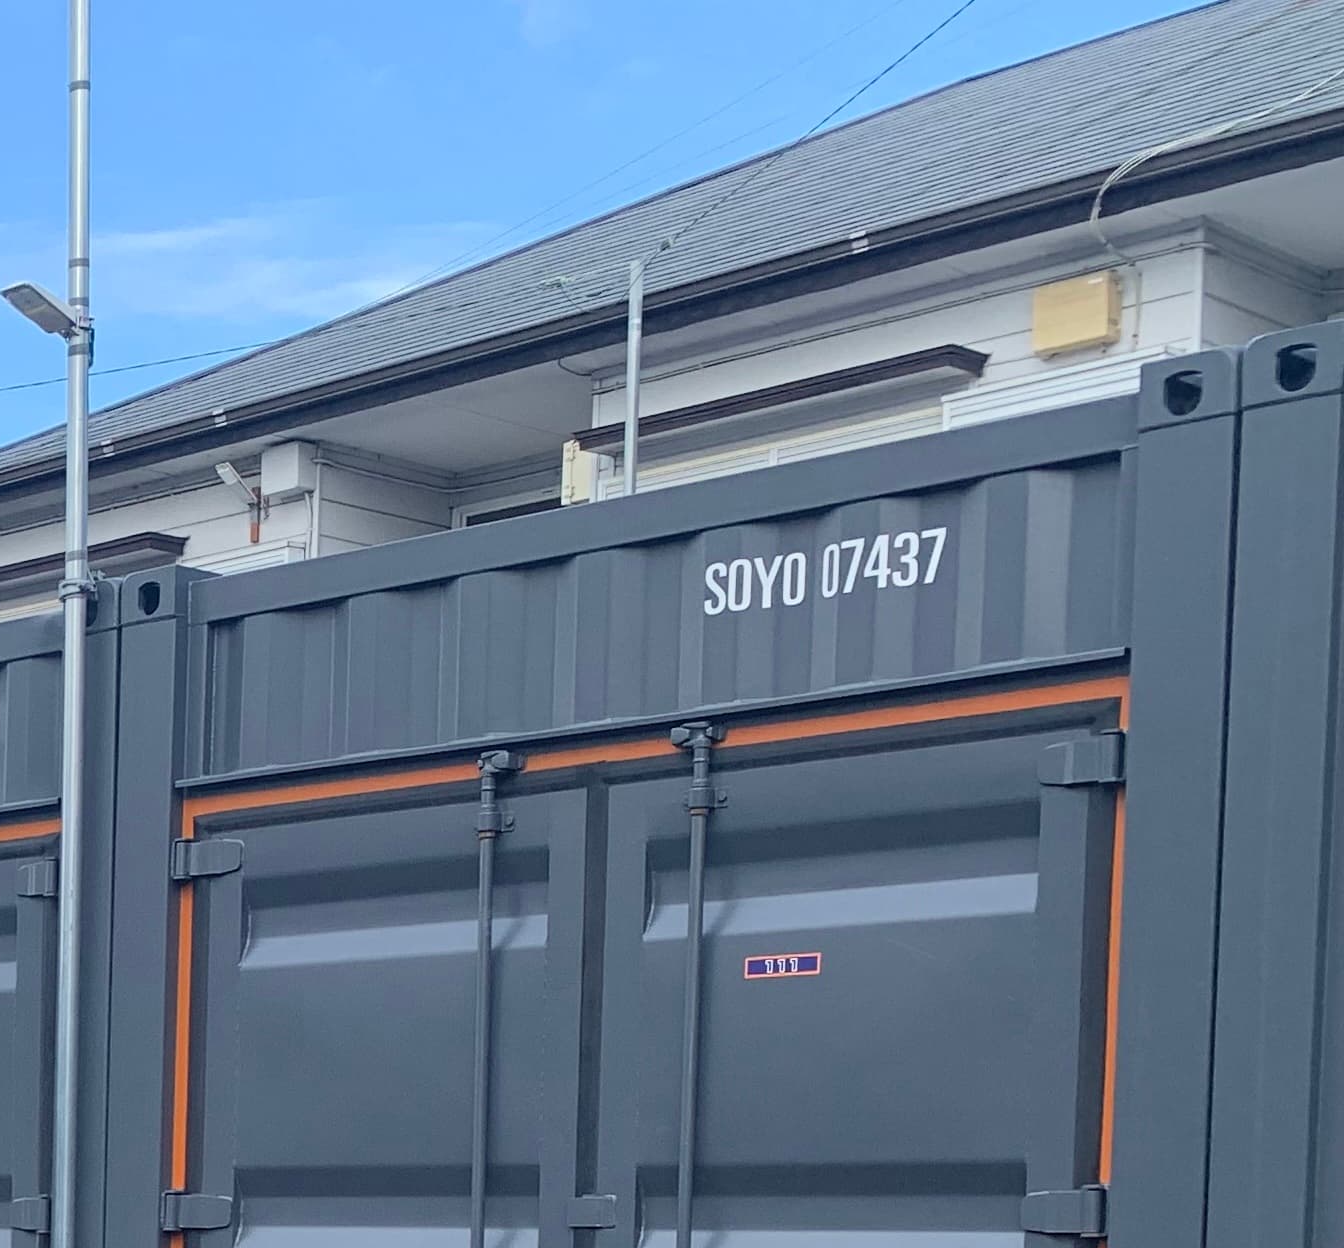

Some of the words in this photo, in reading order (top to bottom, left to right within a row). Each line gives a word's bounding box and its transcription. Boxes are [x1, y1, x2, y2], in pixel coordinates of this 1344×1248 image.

[703, 552, 807, 616] SOYO
[821, 526, 948, 599] 07437
[764, 957, 799, 974] 111
